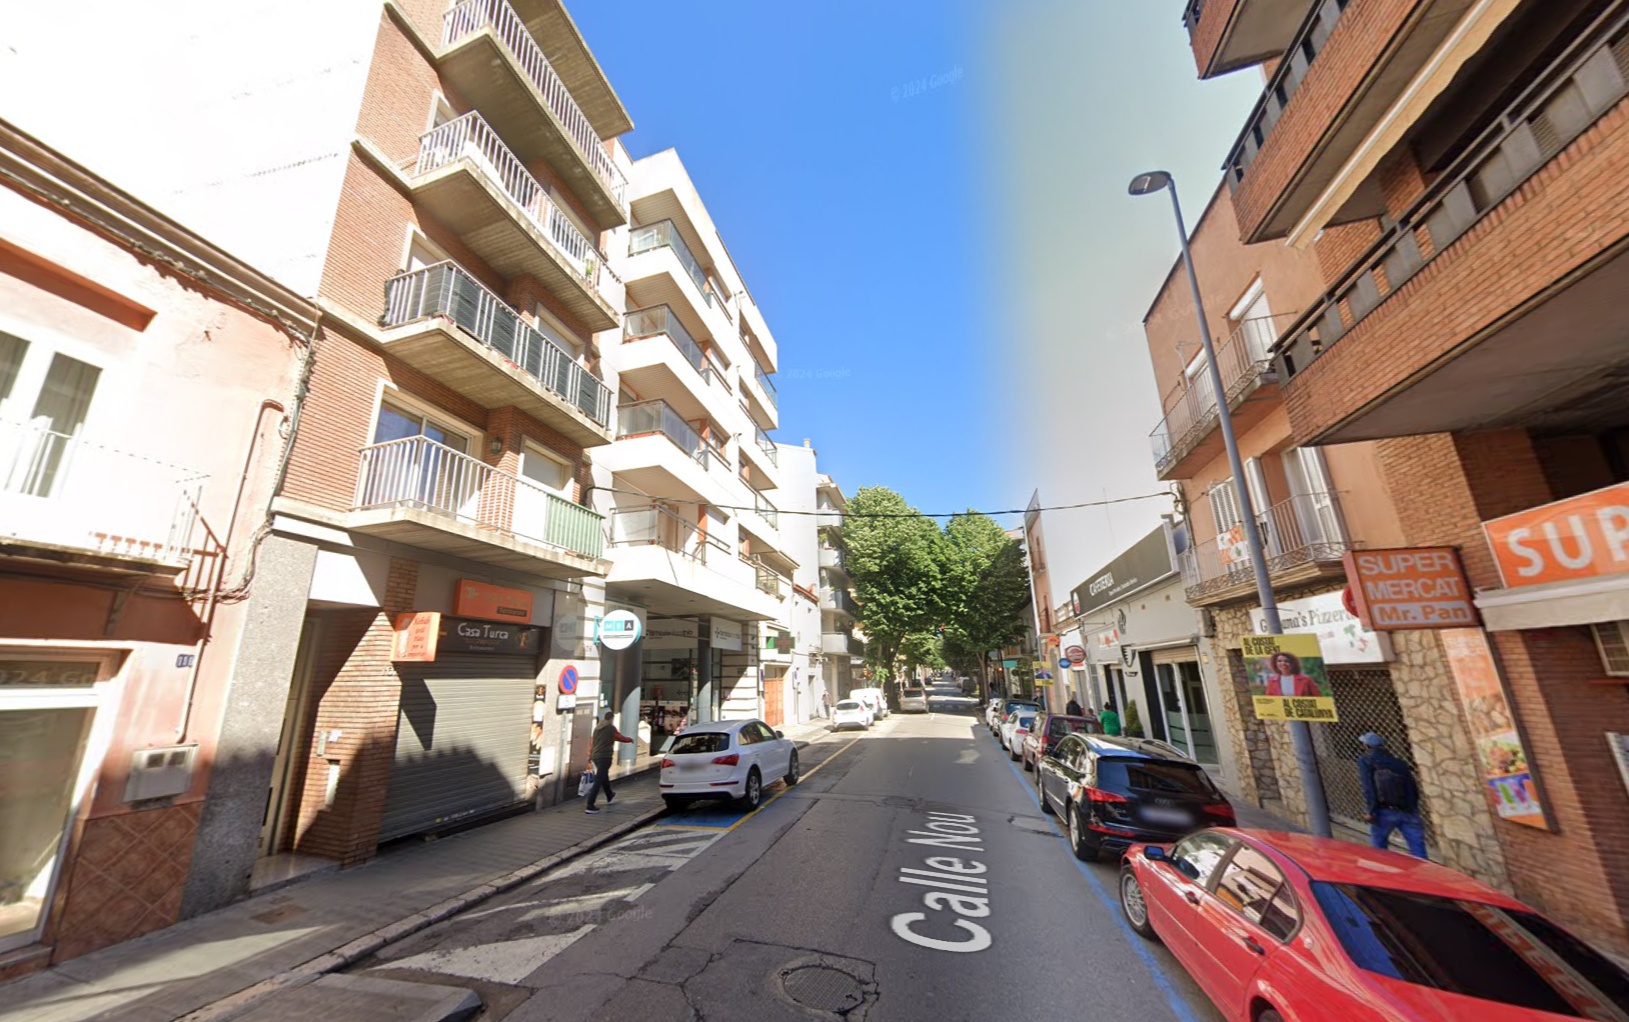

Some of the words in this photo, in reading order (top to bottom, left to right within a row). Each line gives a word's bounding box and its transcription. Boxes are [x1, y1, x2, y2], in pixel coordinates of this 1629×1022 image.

[1358, 551, 1455, 575] SUPER
[1365, 577, 1459, 600] MERCAT
[1378, 605, 1417, 622] Mr.
[1420, 604, 1468, 621] Pan
[457, 622, 480, 637] Casa
[483, 624, 509, 639] Turca
